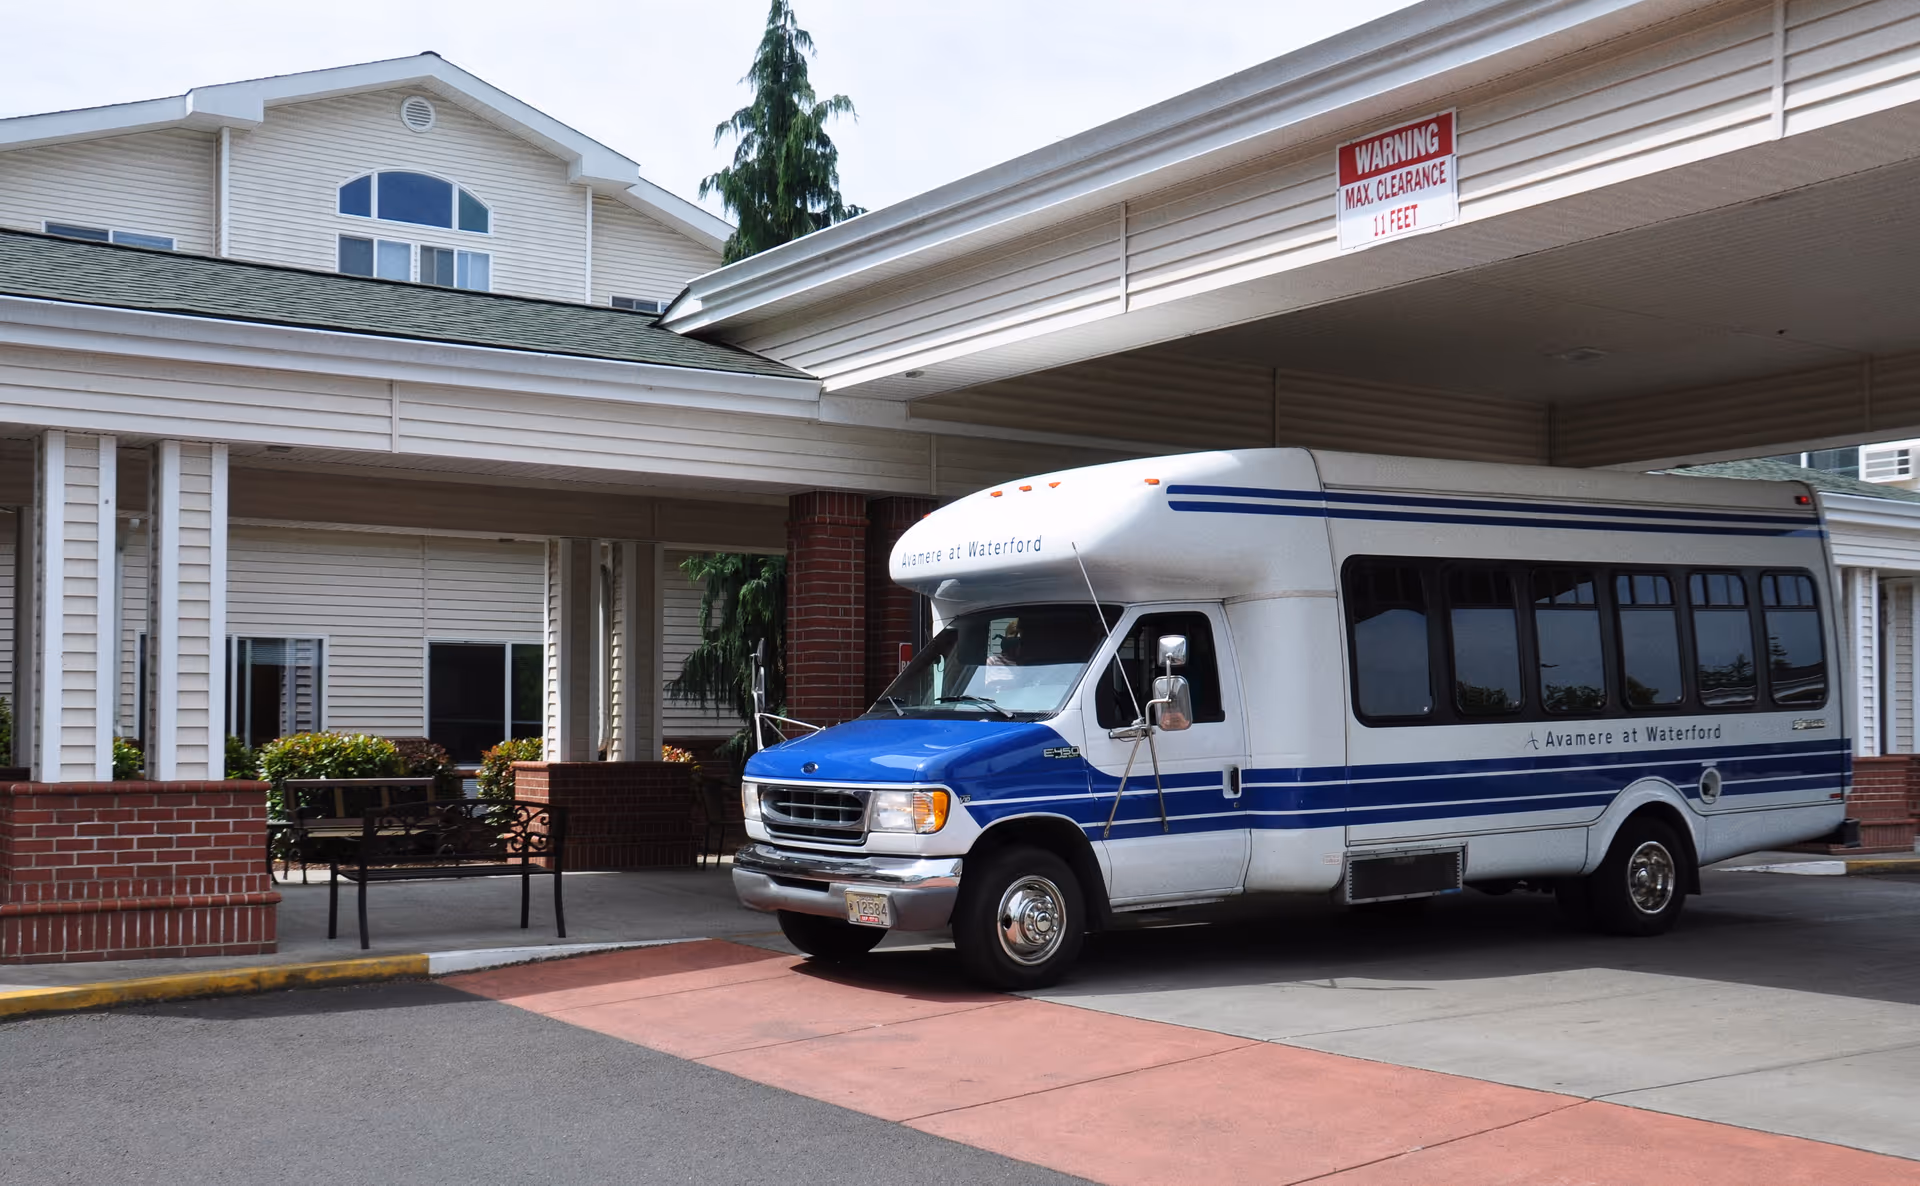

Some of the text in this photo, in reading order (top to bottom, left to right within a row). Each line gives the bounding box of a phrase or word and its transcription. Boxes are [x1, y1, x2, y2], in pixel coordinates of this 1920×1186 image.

[1355, 122, 1439, 176] WARNING
[1345, 160, 1447, 211] MAX. CLEARANCE
[1374, 203, 1418, 237] 11 FEET
[901, 535, 1042, 569] Avamere at Waterford
[1043, 746, 1080, 758] E450
[1545, 724, 1721, 748] Avamere at Waterford
[856, 900, 888, 917] 12584
